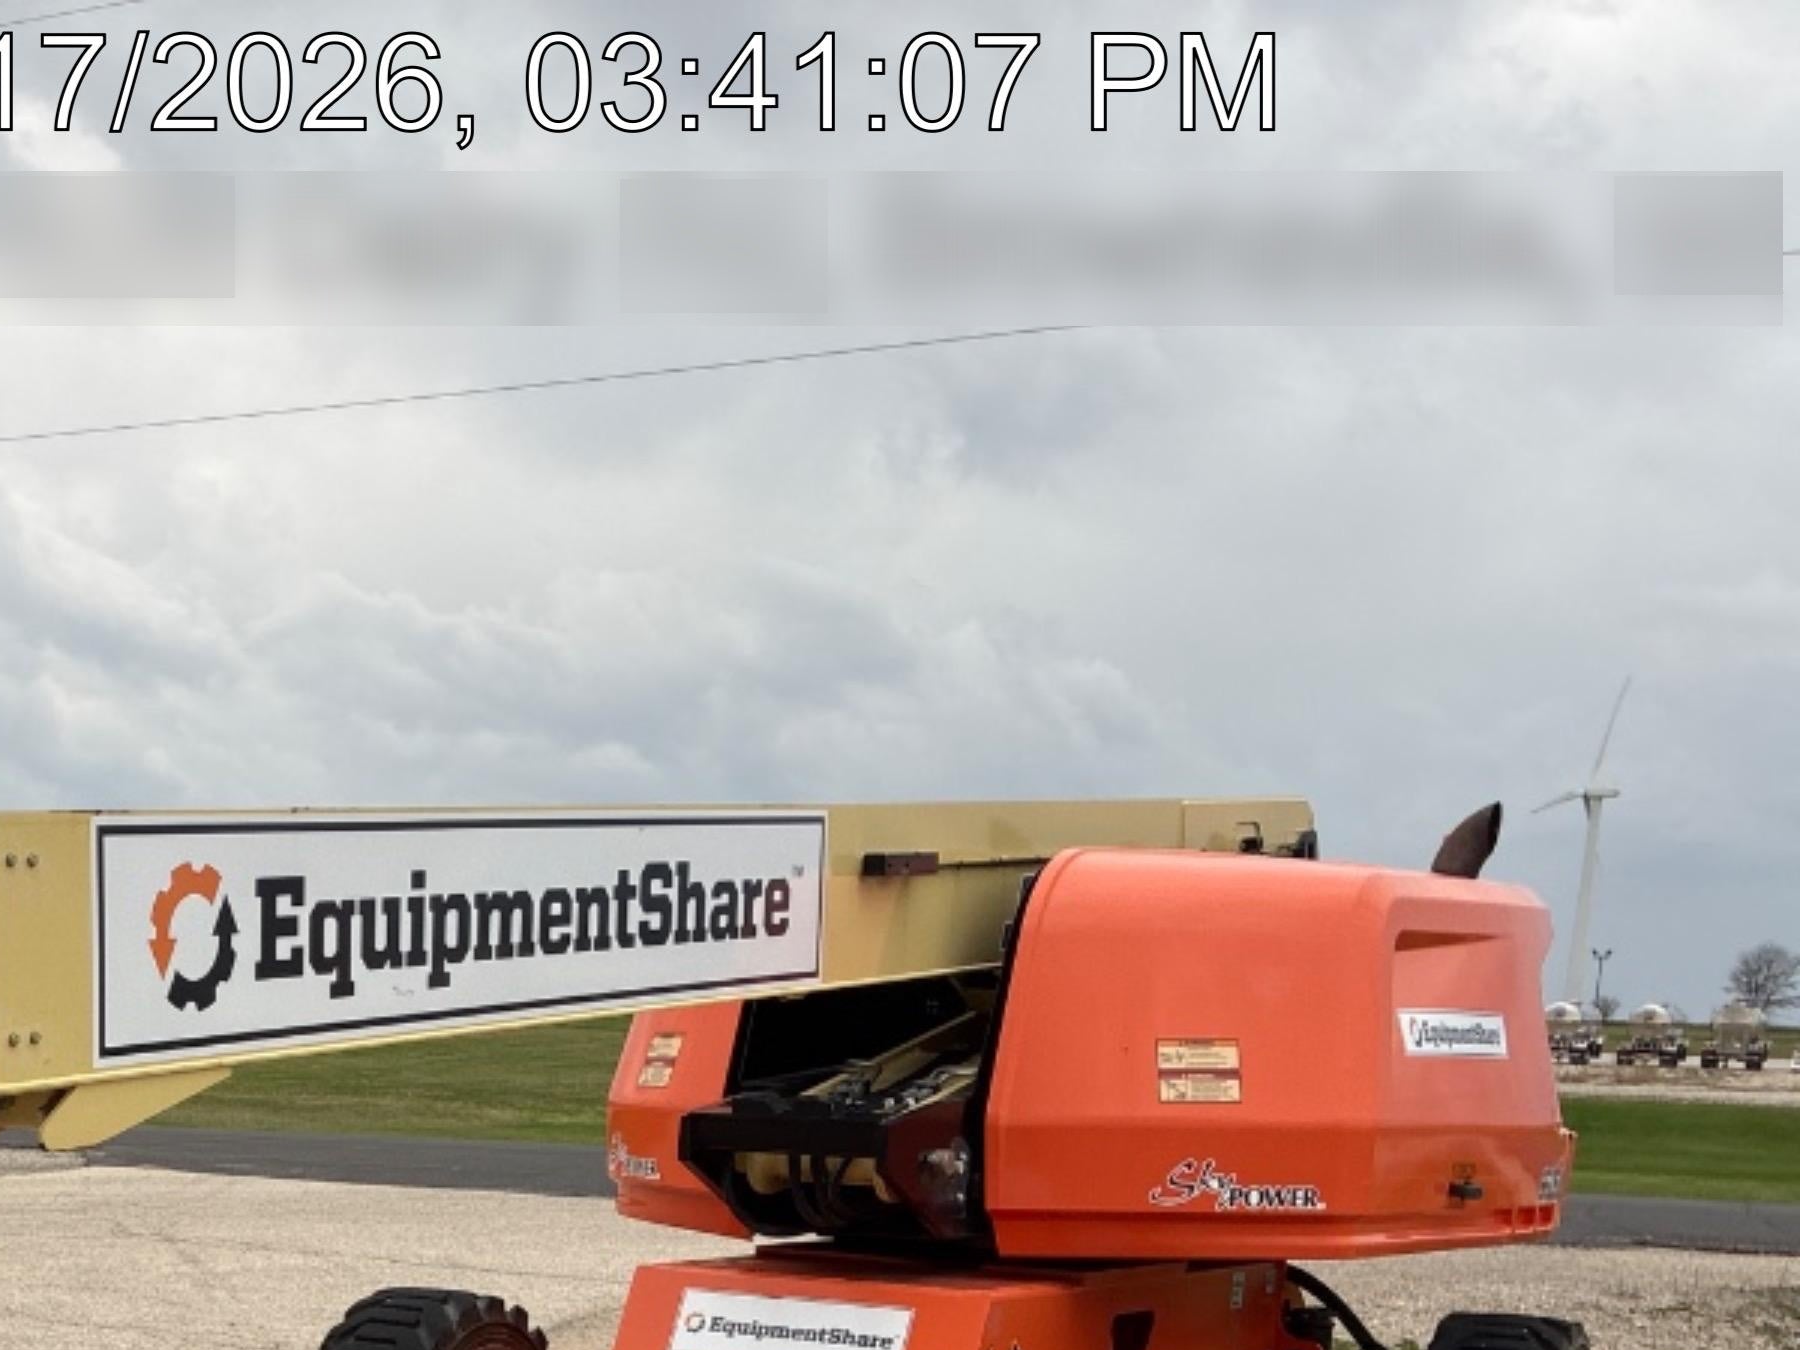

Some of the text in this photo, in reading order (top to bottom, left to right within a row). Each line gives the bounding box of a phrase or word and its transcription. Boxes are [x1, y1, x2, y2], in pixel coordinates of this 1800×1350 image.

[254, 861, 790, 999] EquipmentShare
[1227, 1186, 1320, 1209] POWER
[708, 1315, 894, 1350] EquipmentShare
